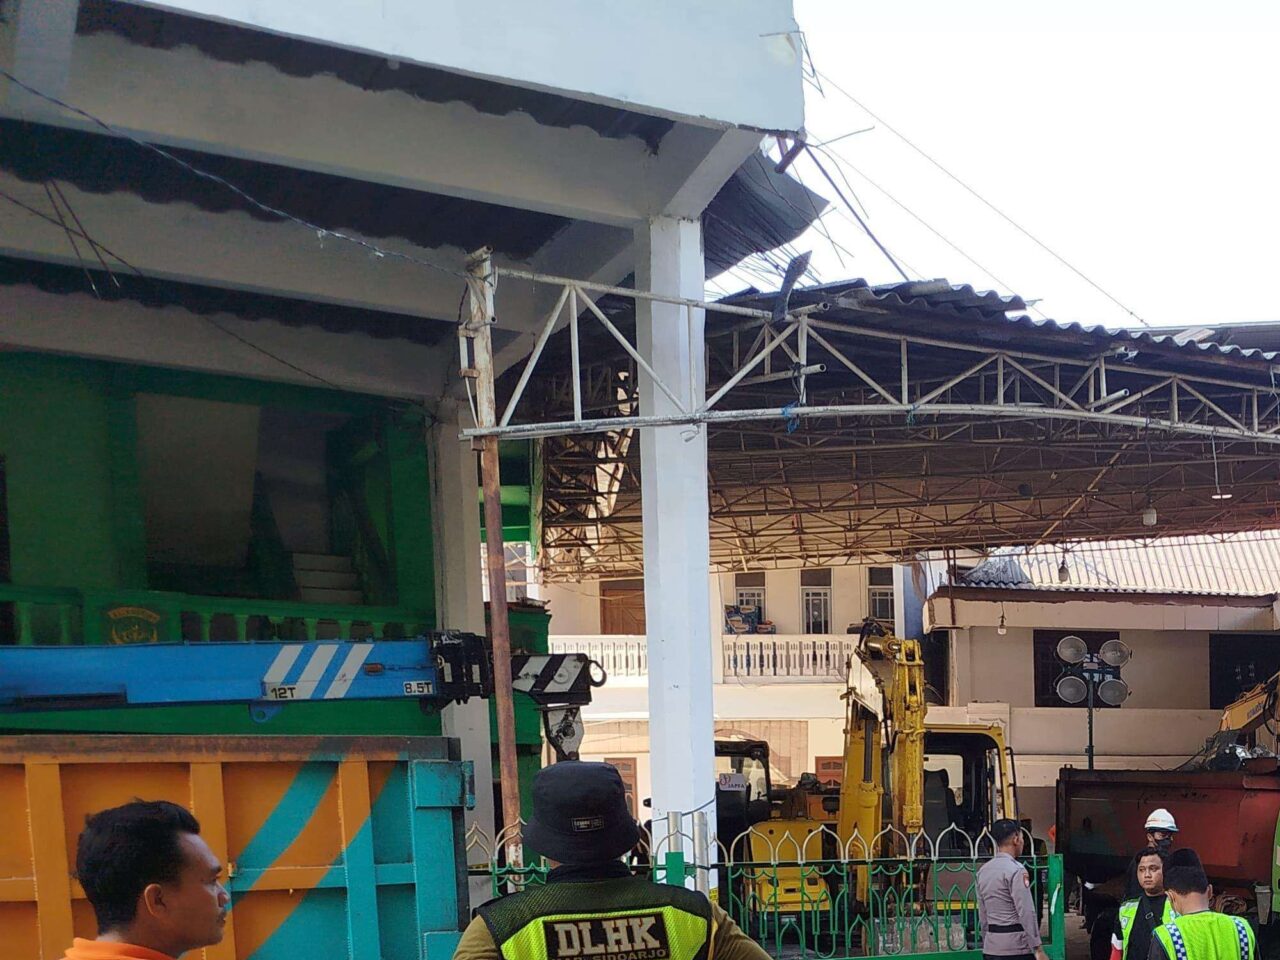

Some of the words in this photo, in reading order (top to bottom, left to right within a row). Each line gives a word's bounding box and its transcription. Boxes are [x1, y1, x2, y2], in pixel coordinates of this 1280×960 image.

[271, 687, 296, 699] 12T
[404, 682, 432, 694] 8.5T
[554, 916, 660, 957] DLHK
